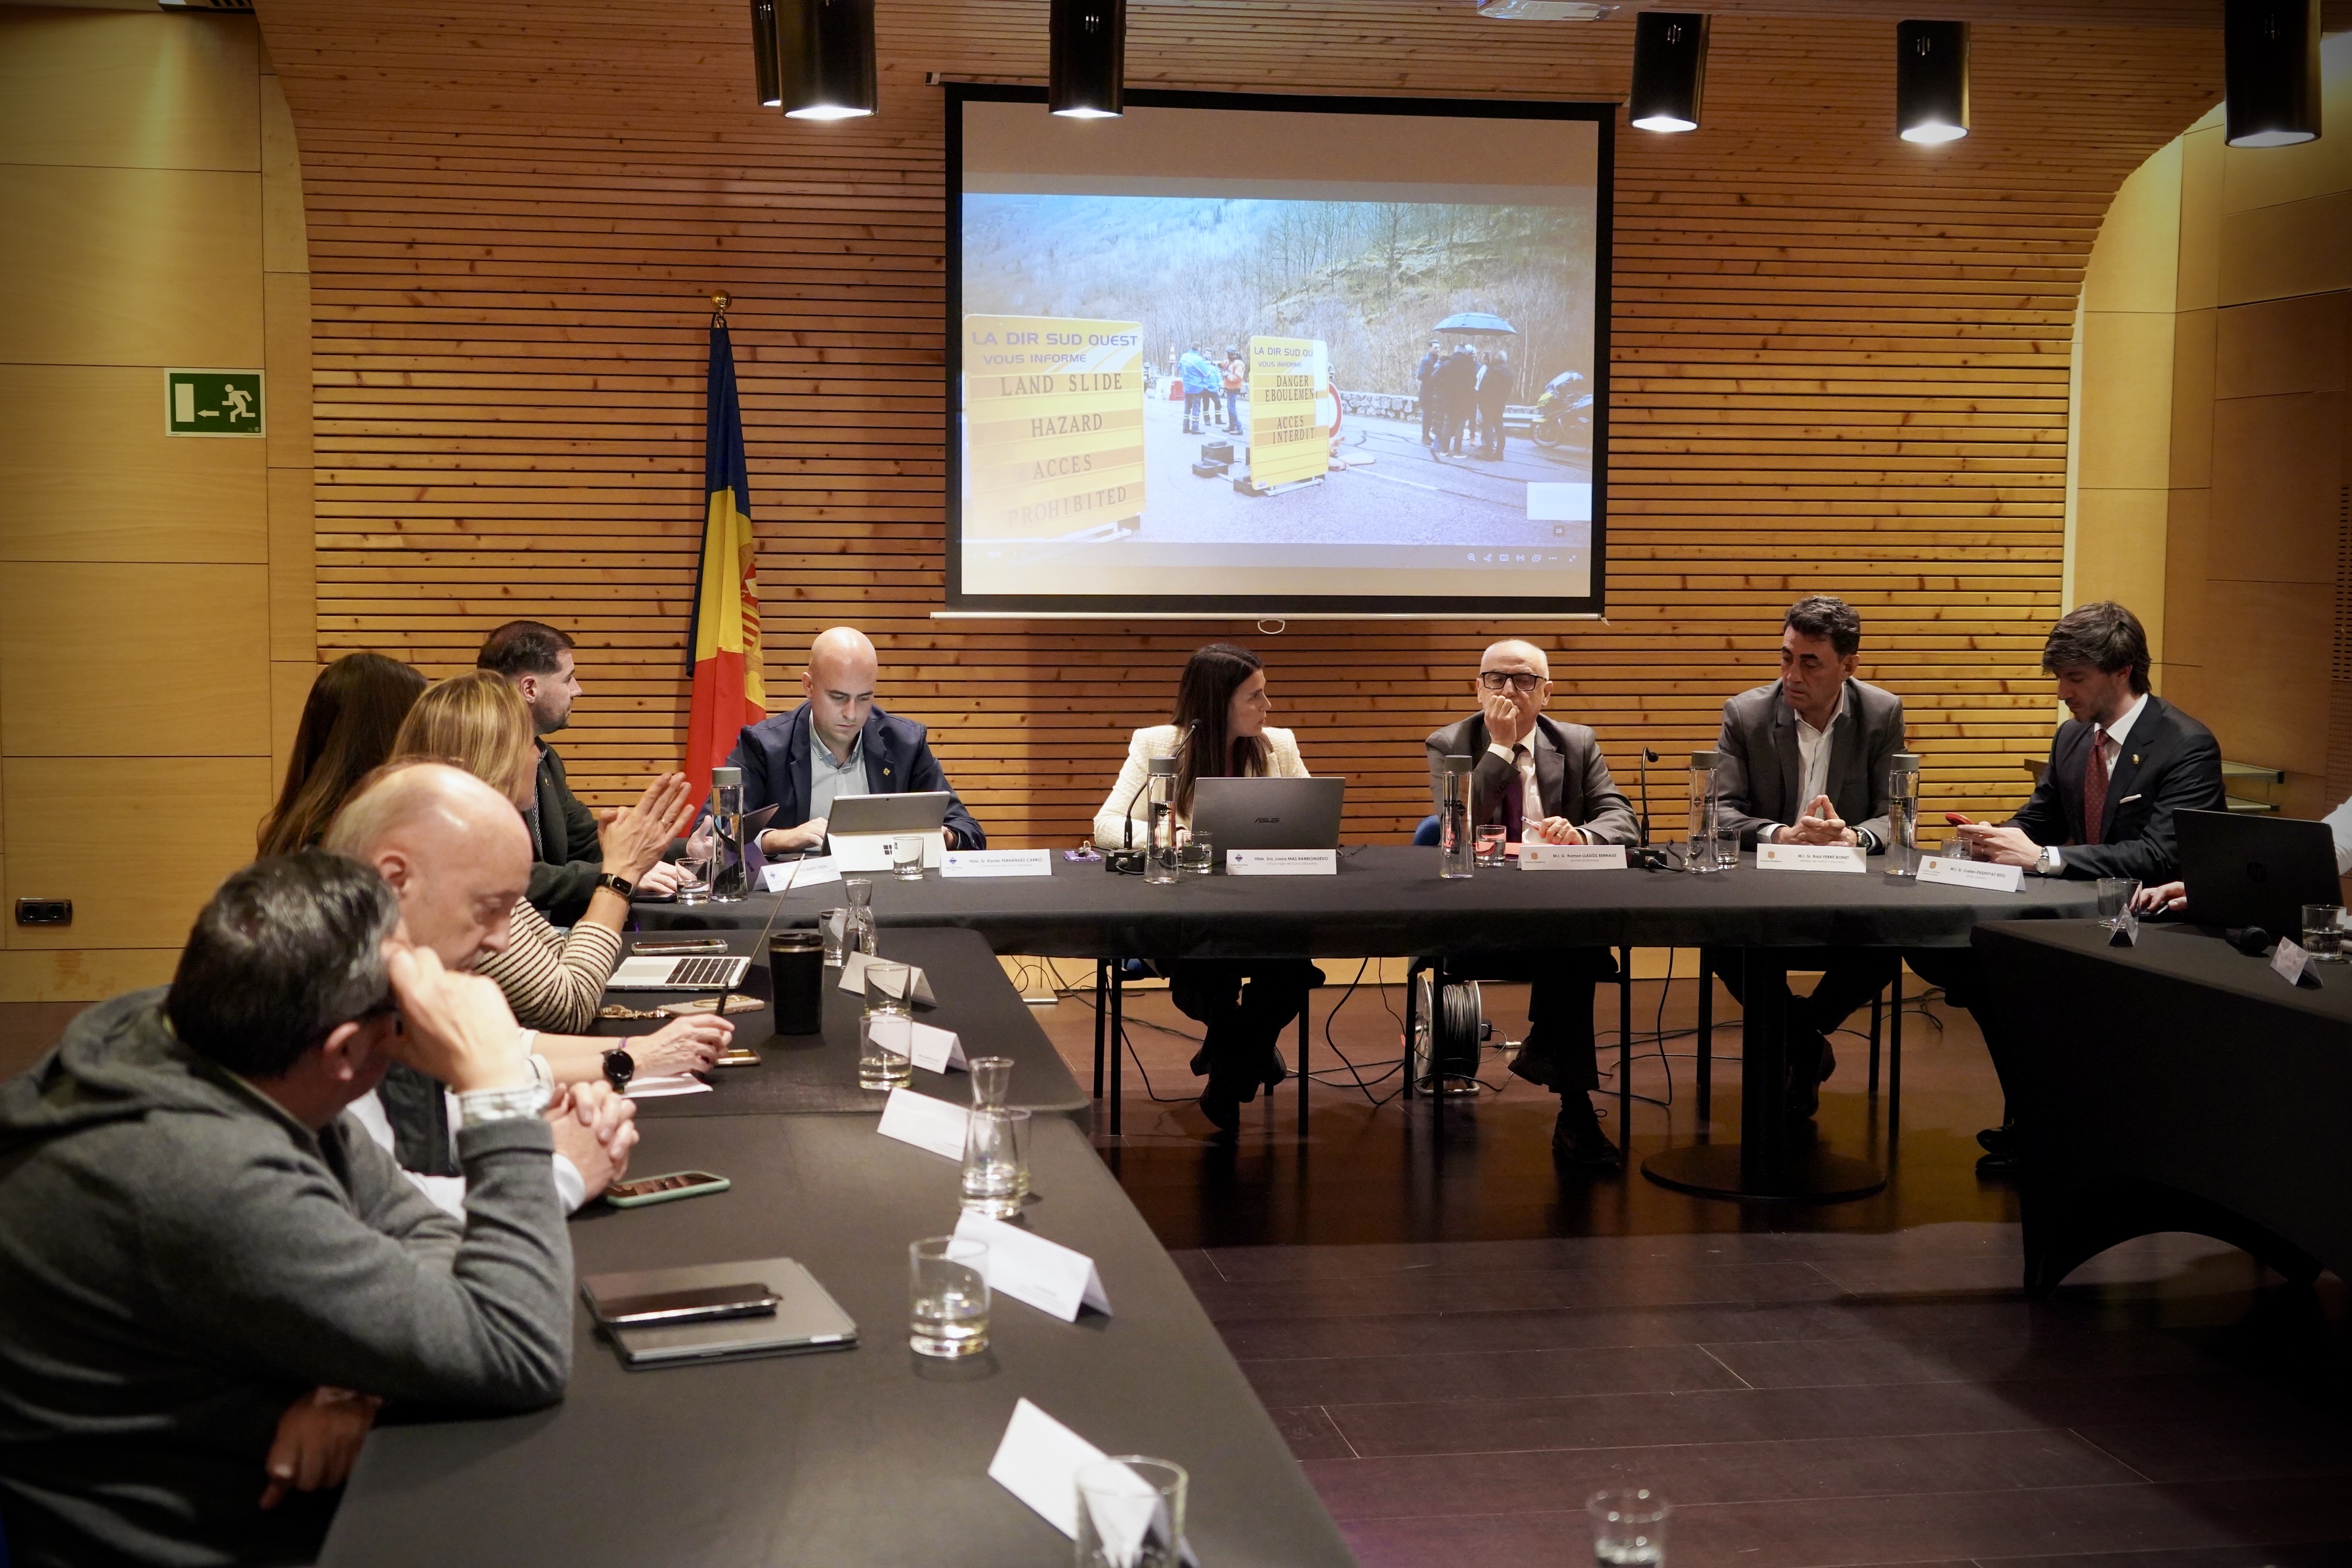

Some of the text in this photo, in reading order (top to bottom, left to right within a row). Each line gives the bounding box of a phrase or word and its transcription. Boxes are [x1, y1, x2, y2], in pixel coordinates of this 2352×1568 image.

[972, 332, 1138, 347] LA DIR SUD OUEST
[982, 354, 1087, 365] VOUS INFORME
[1254, 347, 1264, 356] LA
[1267, 347, 1281, 356] DIR
[1284, 348, 1300, 357] SUD
[1000, 373, 1123, 397] LAND SLIDE
[1276, 375, 1309, 388] DANGER
[1031, 414, 1102, 438] HAZARD
[1277, 415, 1304, 429] ACCES
[1273, 427, 1315, 445] INTERDIT
[1033, 454, 1092, 480] ACCES
[1007, 486, 1126, 528] PROHIBITED
